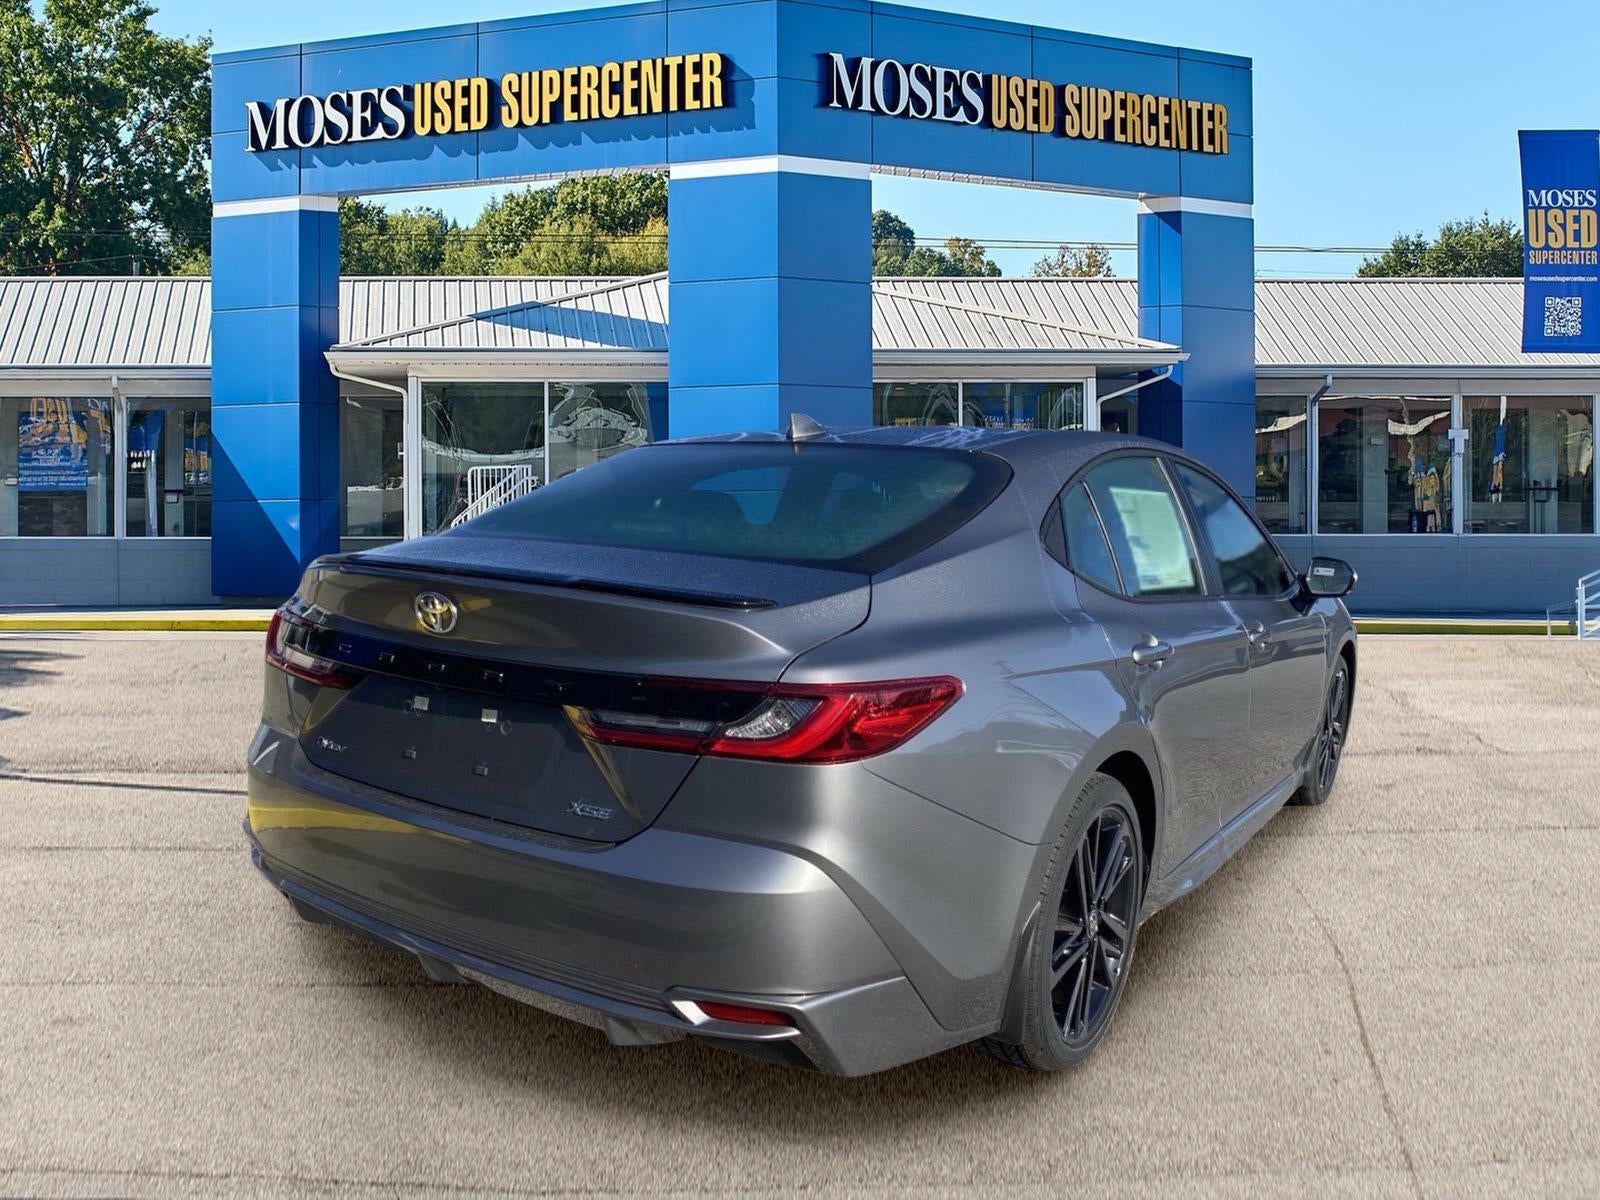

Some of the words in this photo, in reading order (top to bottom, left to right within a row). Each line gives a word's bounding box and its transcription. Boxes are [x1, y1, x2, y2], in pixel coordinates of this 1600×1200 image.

[245, 84, 406, 153] MOSES
[412, 76, 490, 137] USED
[500, 51, 725, 129] SUPERCENTER
[828, 51, 985, 126] MOSES
[990, 73, 1056, 134] USED
[1064, 83, 1230, 155] SUPERCENTER
[1527, 188, 1597, 207] MOSES
[1527, 208, 1598, 249] USED
[1529, 249, 1598, 265] SUPERCENTER
